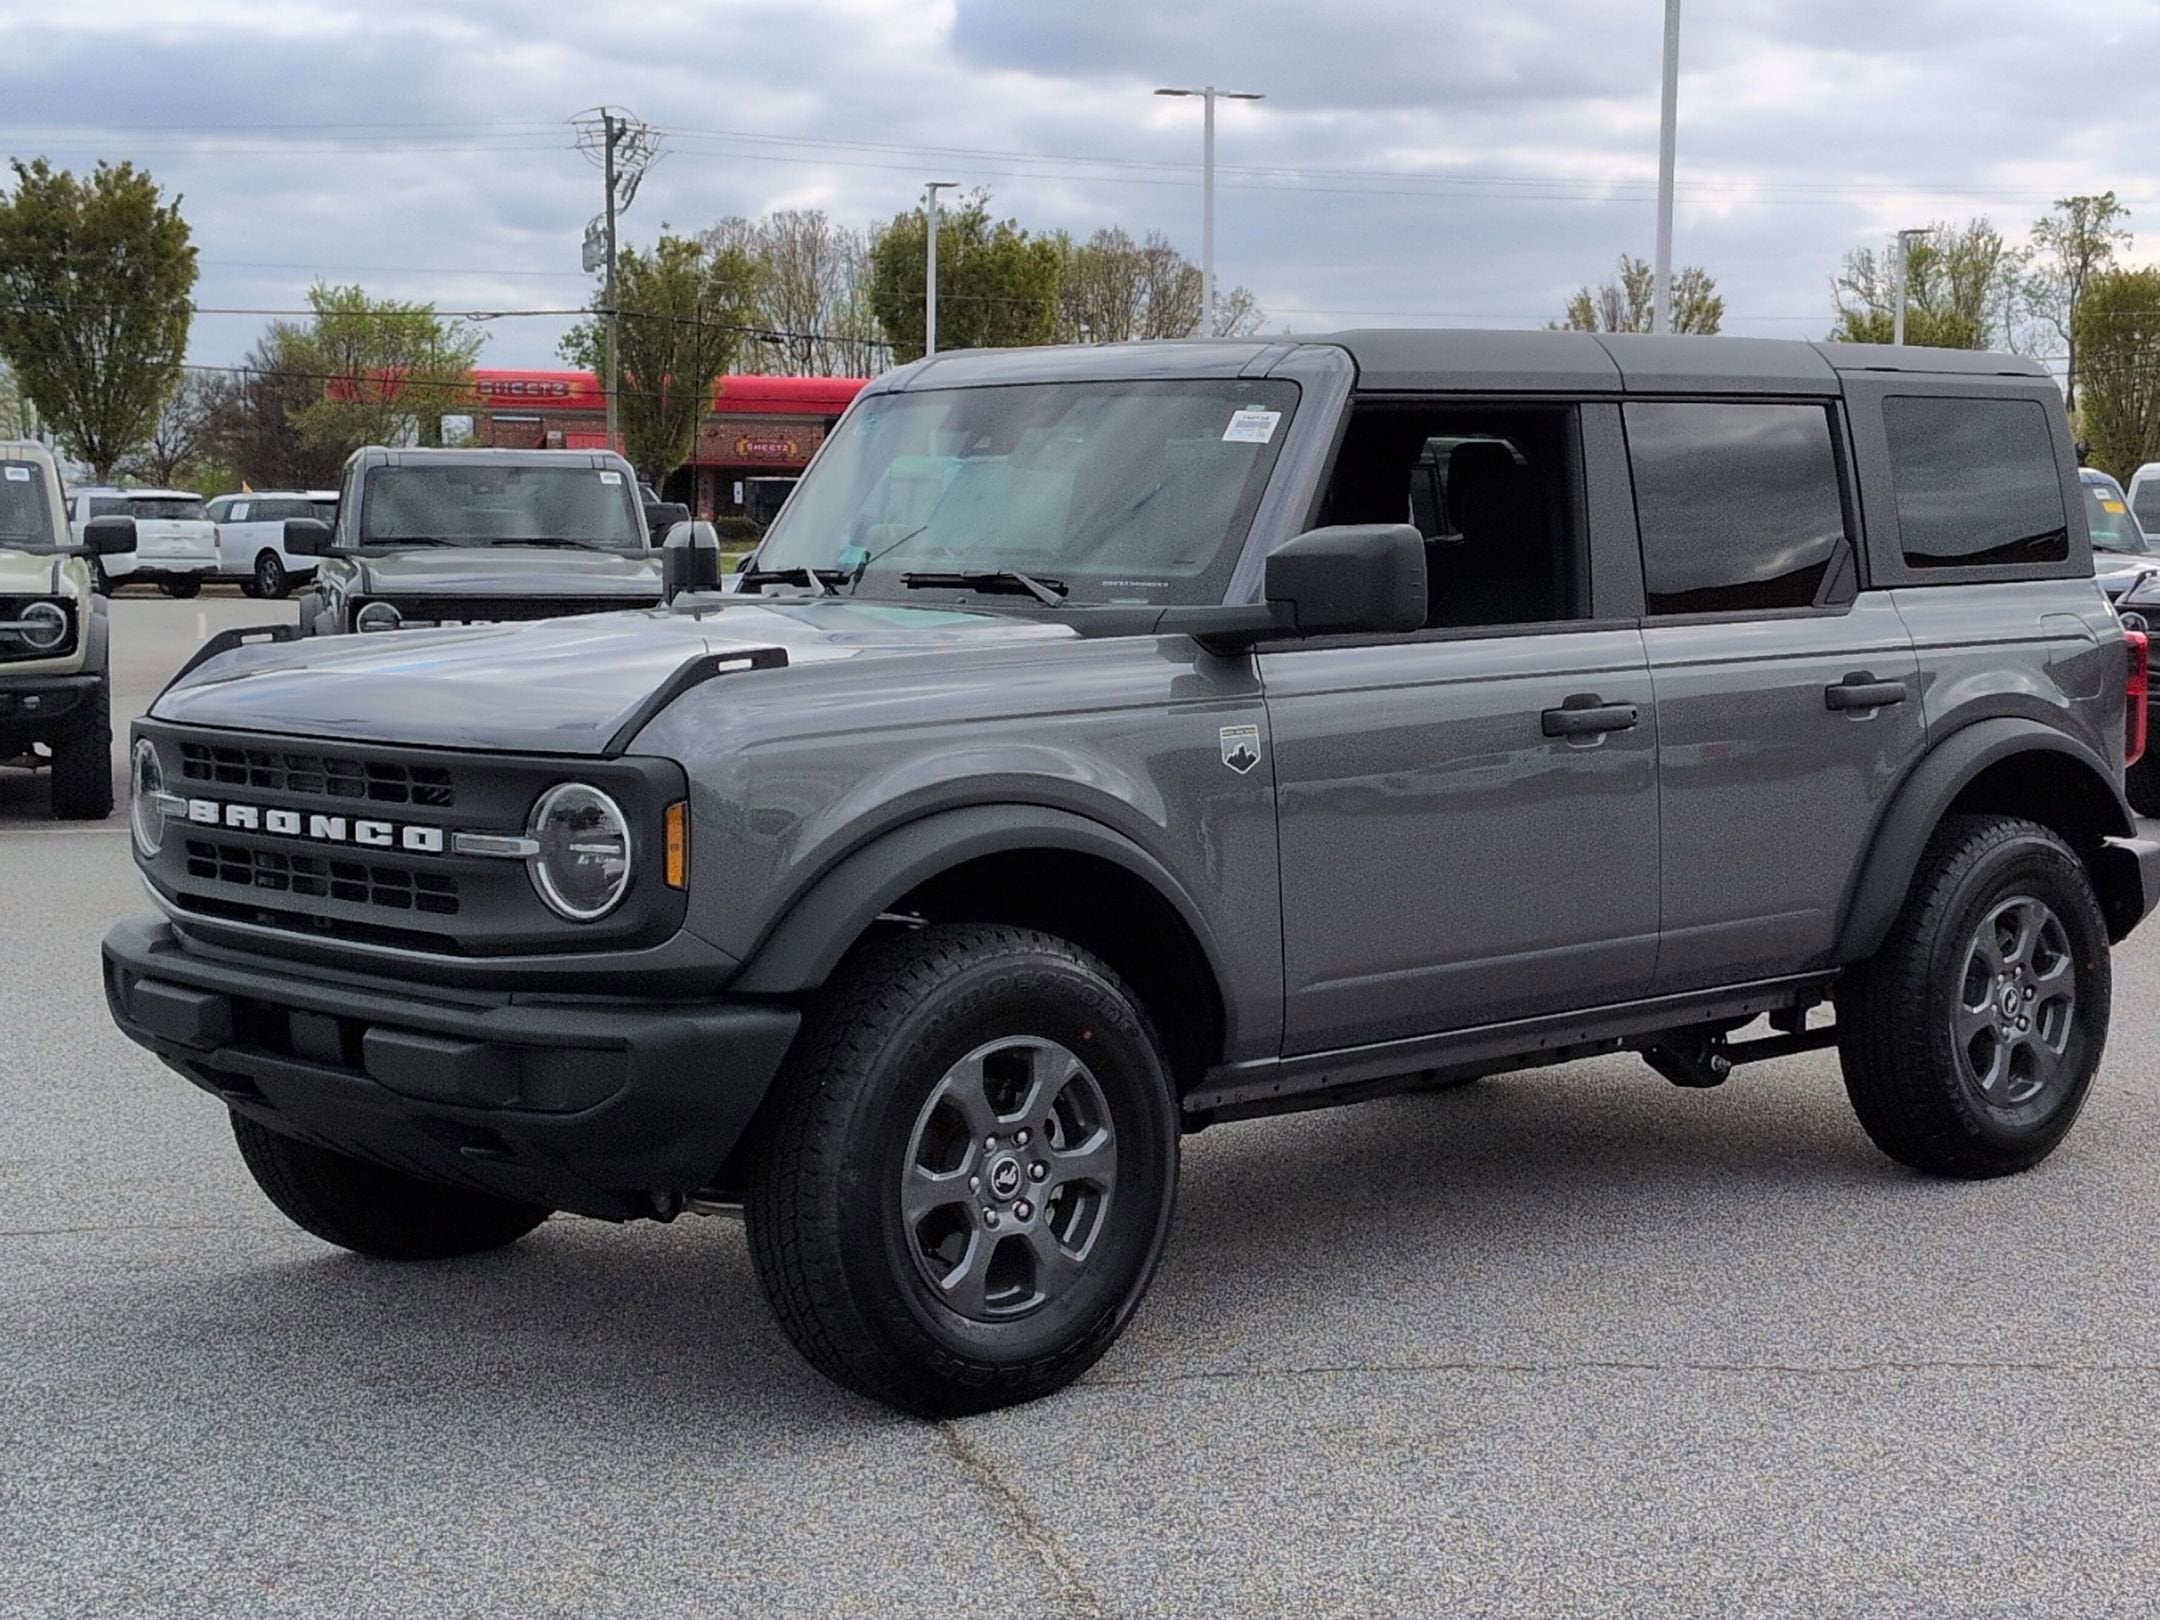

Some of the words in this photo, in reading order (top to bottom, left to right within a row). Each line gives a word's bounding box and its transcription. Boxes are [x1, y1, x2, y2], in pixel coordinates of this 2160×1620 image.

[480, 381, 565, 397] SHEETZ
[746, 442, 789, 453] SHEETZ
[188, 799, 443, 852] BRONCO
